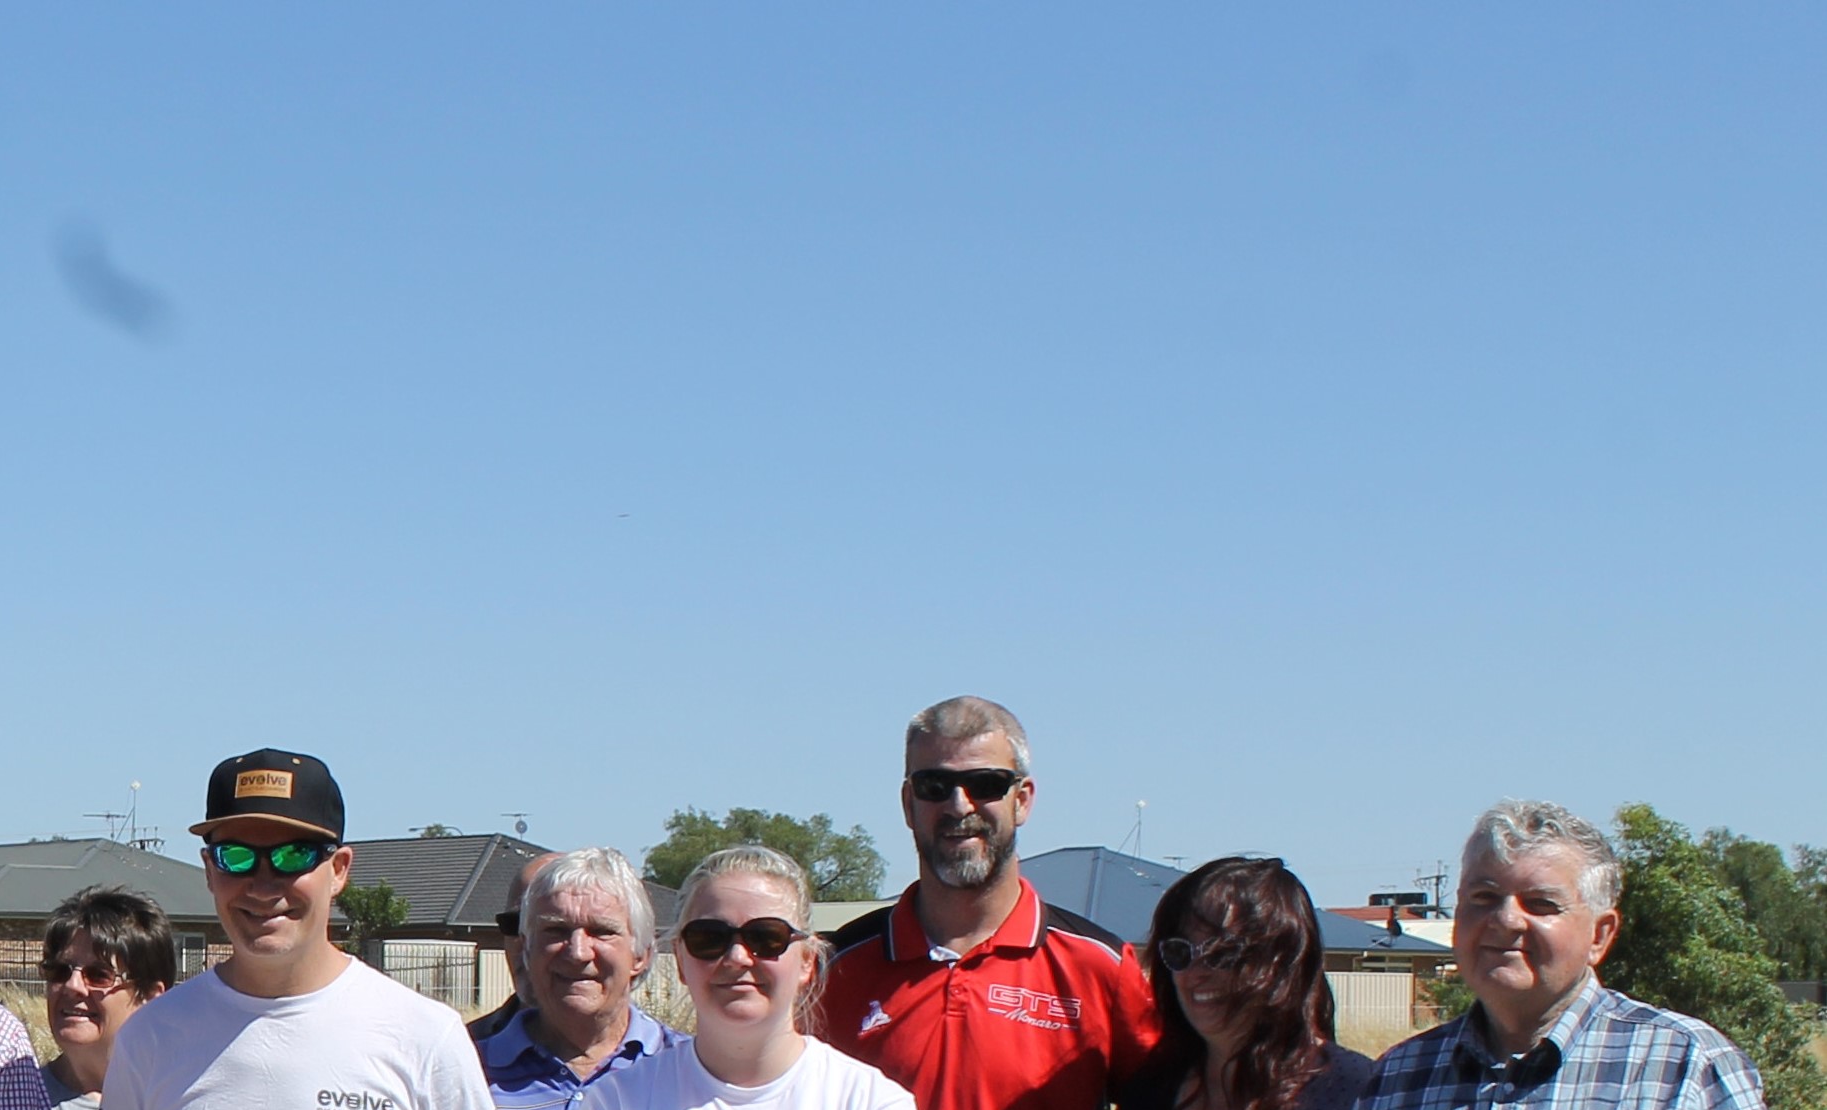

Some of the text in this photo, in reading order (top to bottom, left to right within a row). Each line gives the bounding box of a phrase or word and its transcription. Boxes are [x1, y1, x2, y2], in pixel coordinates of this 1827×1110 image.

[240, 773, 287, 786] evolve
[988, 983, 1082, 1019] GTS
[1005, 1006, 1062, 1030] Monaro
